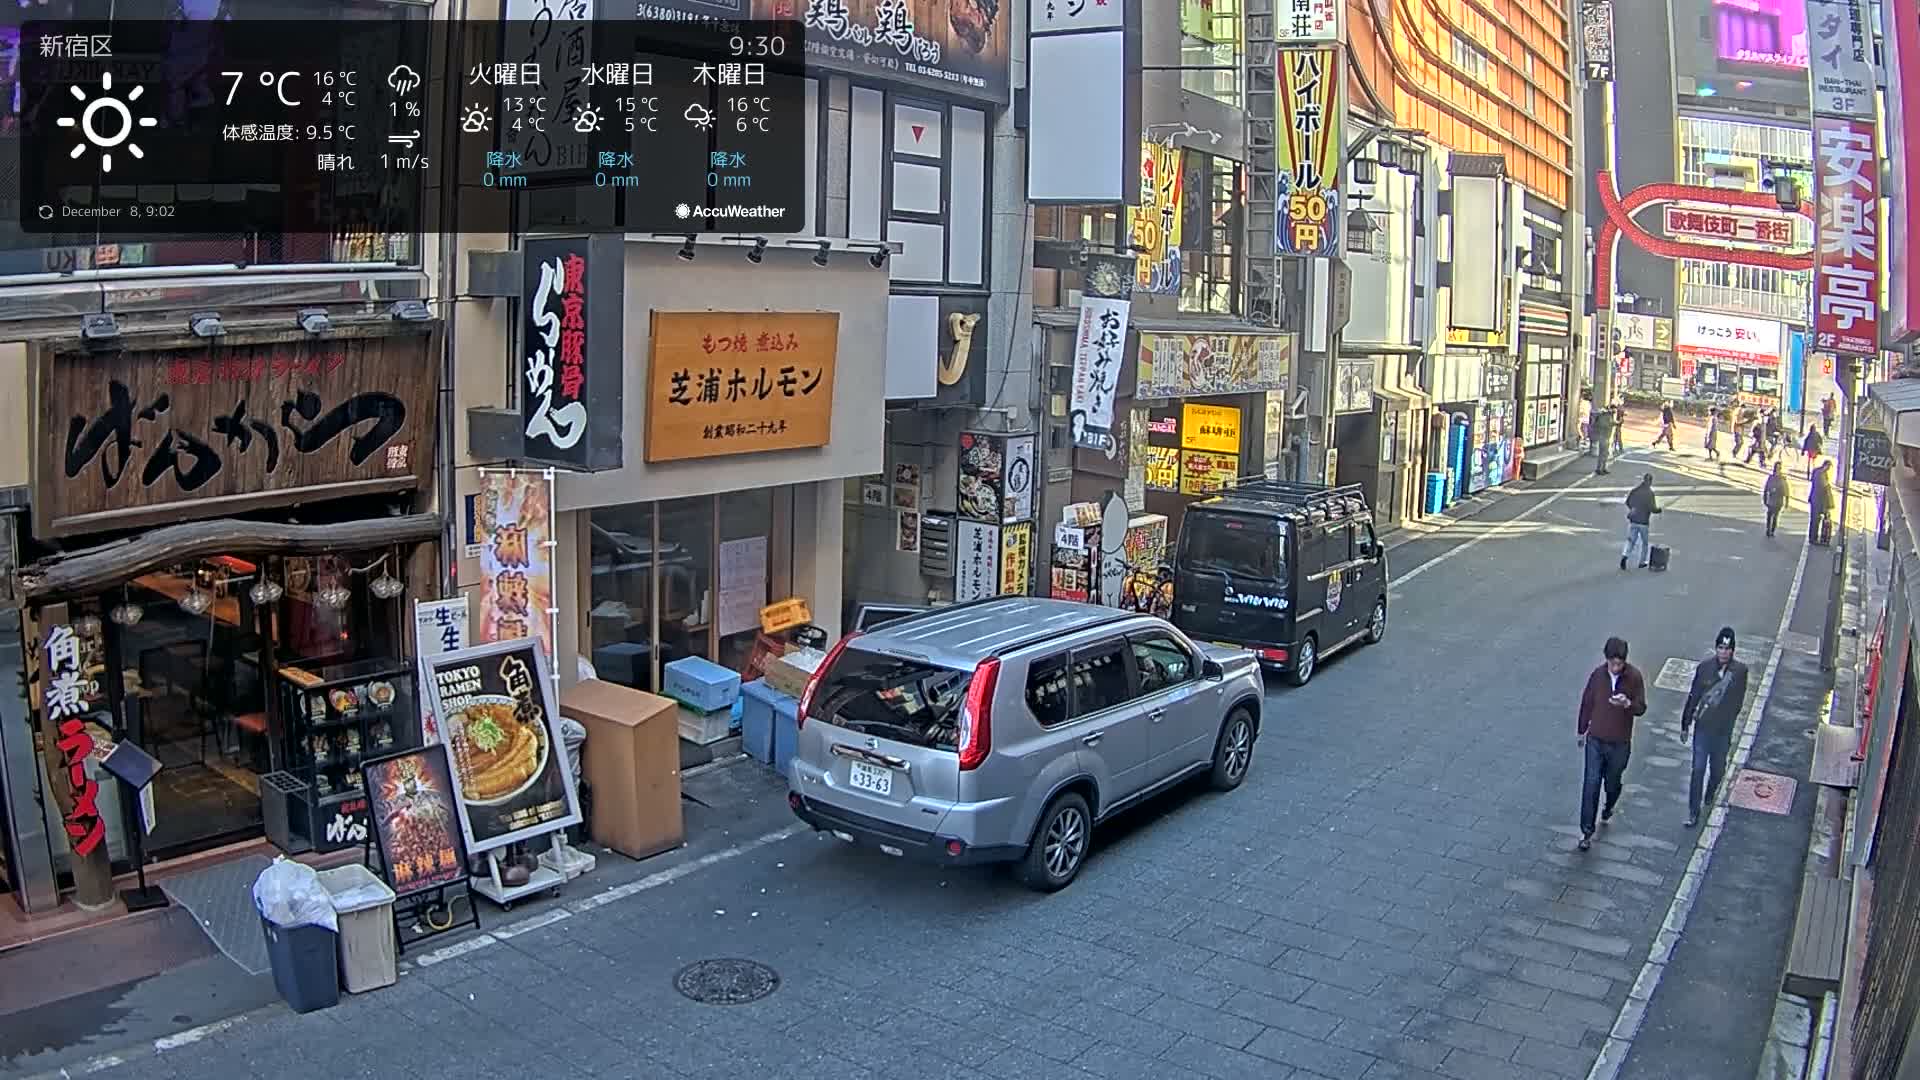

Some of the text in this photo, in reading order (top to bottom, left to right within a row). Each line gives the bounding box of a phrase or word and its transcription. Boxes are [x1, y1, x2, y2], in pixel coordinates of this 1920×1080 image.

[1589, 64, 1609, 78] 7F
[1832, 97, 1856, 111] 3F
[1296, 54, 1320, 189] ハイボール
[1290, 196, 1326, 221] 50
[1295, 224, 1319, 249] 円
[1669, 210, 1790, 242] 歌舞伎町一番街
[1819, 126, 1875, 329] 安楽亭
[1818, 333, 1836, 346] 2F
[668, 365, 823, 405] 芝浦ホルモン
[65, 381, 406, 491] ばんから
[435, 665, 481, 685] TOKYO
[440, 678, 482, 698] RAMEN
[441, 694, 472, 711] SHOP
[44, 625, 105, 856] 角煮ラーメン
